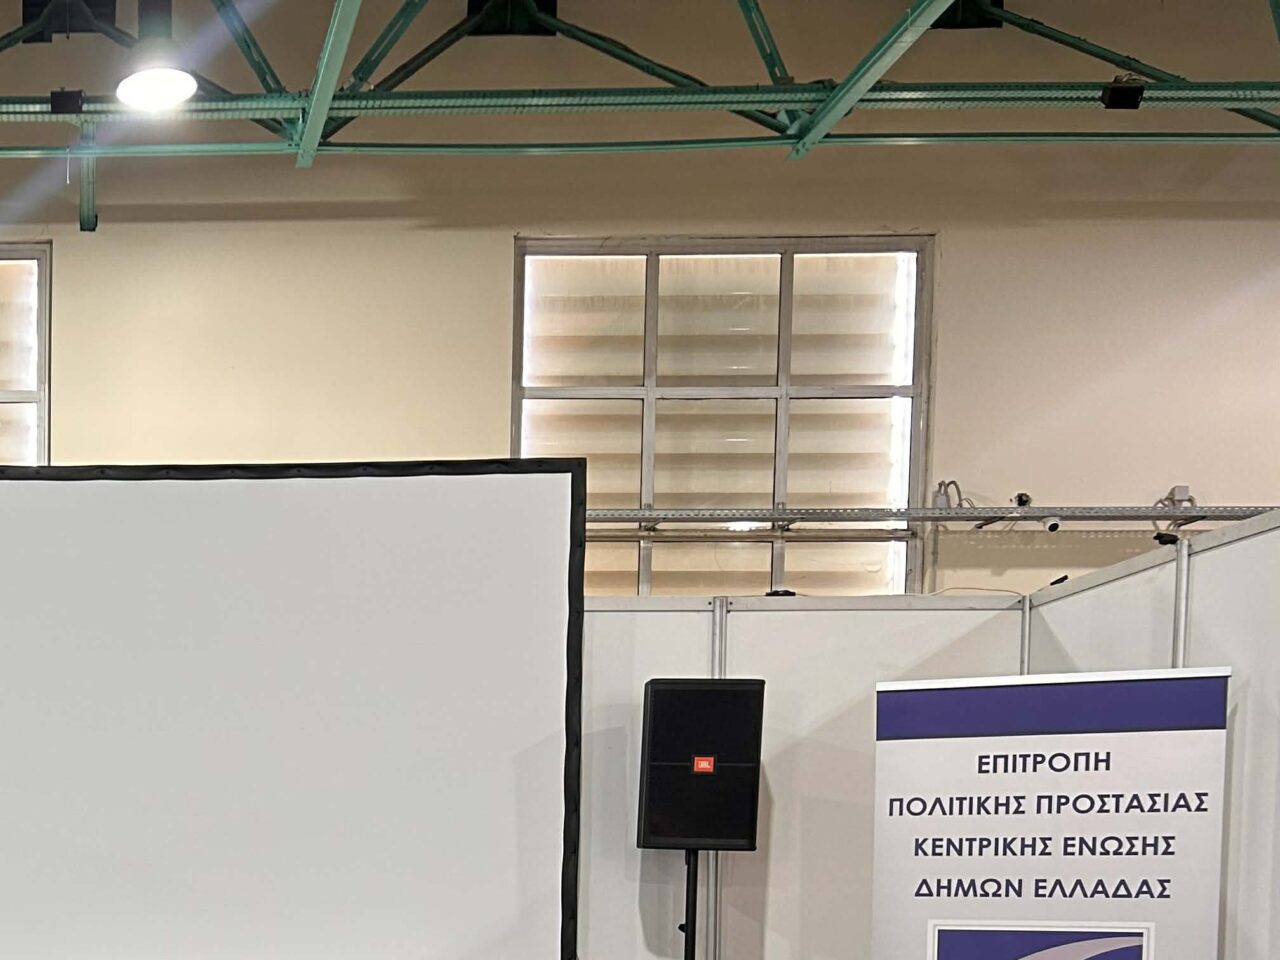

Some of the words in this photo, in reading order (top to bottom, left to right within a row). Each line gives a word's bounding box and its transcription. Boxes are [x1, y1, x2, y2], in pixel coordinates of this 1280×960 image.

[977, 751, 1111, 774] ΕΠΙΤΡΟΠΗ
[888, 795, 1026, 817] ΠΟΛΙΤΙΚΗΣ
[1036, 792, 1209, 815] ΠΡΟΣΤΑΣΙΑΣ
[913, 837, 1053, 857] ΚΕΝΤΡΙΚΗΣ
[1062, 836, 1176, 857] ΕΝΩΣΗΣ
[914, 878, 1023, 898] ΔΗΜΩΝ
[1033, 879, 1172, 900] ΕΛΛΑΔΑΣ
